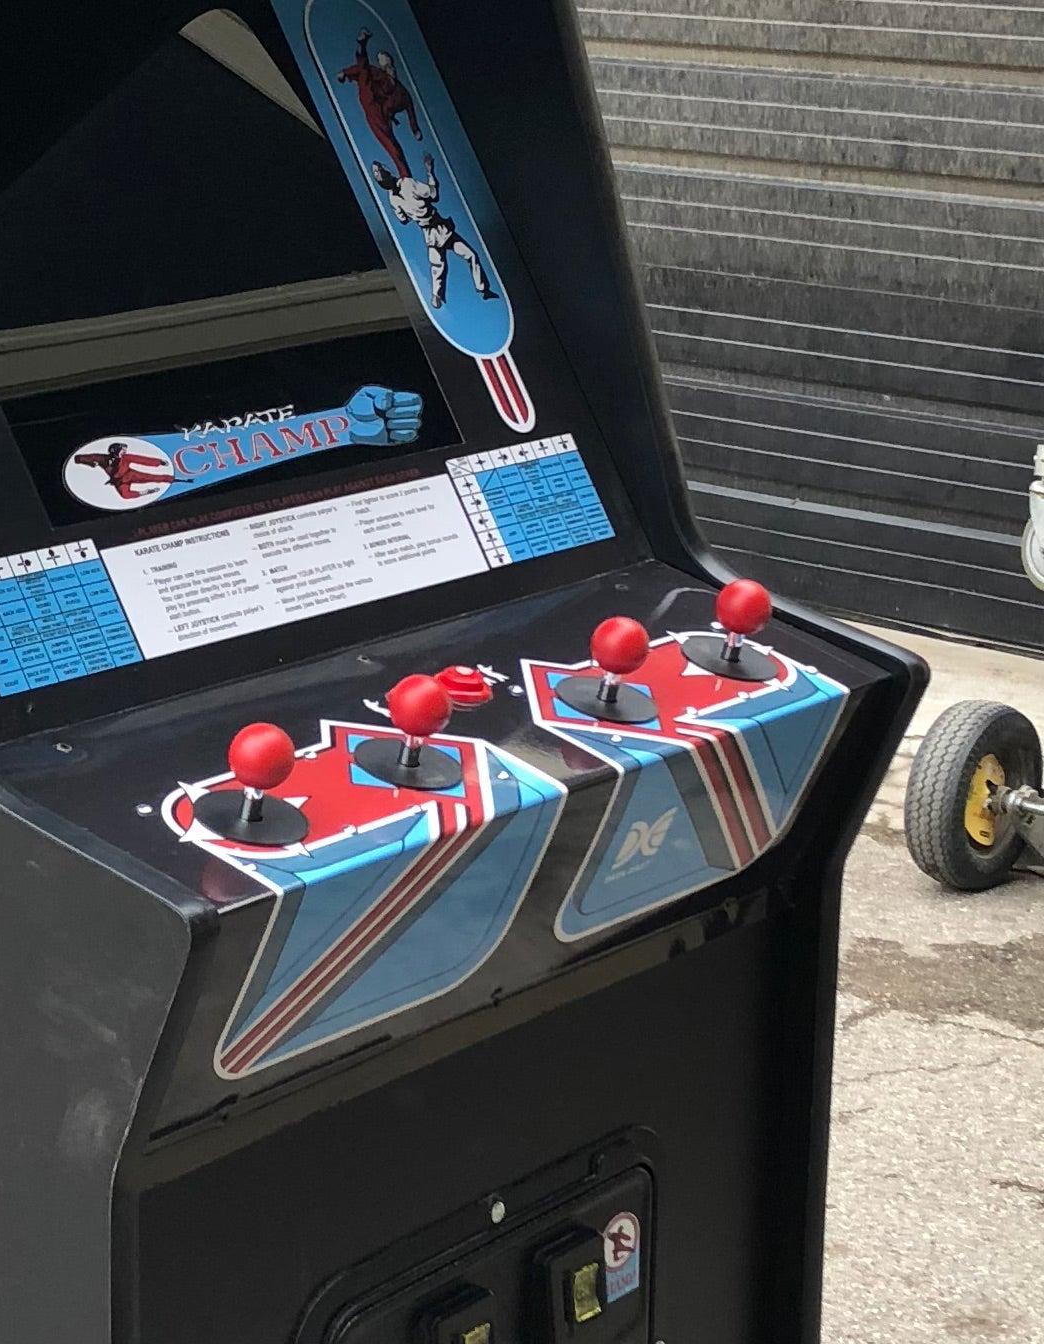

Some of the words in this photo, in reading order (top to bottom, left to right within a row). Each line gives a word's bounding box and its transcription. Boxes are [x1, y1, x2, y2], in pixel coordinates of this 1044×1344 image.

[182, 403, 296, 441] KARATE
[174, 416, 349, 476] CHAMP
[134, 545, 161, 556] KARATE
[161, 540, 183, 550] CHAMP
[184, 529, 230, 545] INSTRUCTIONS
